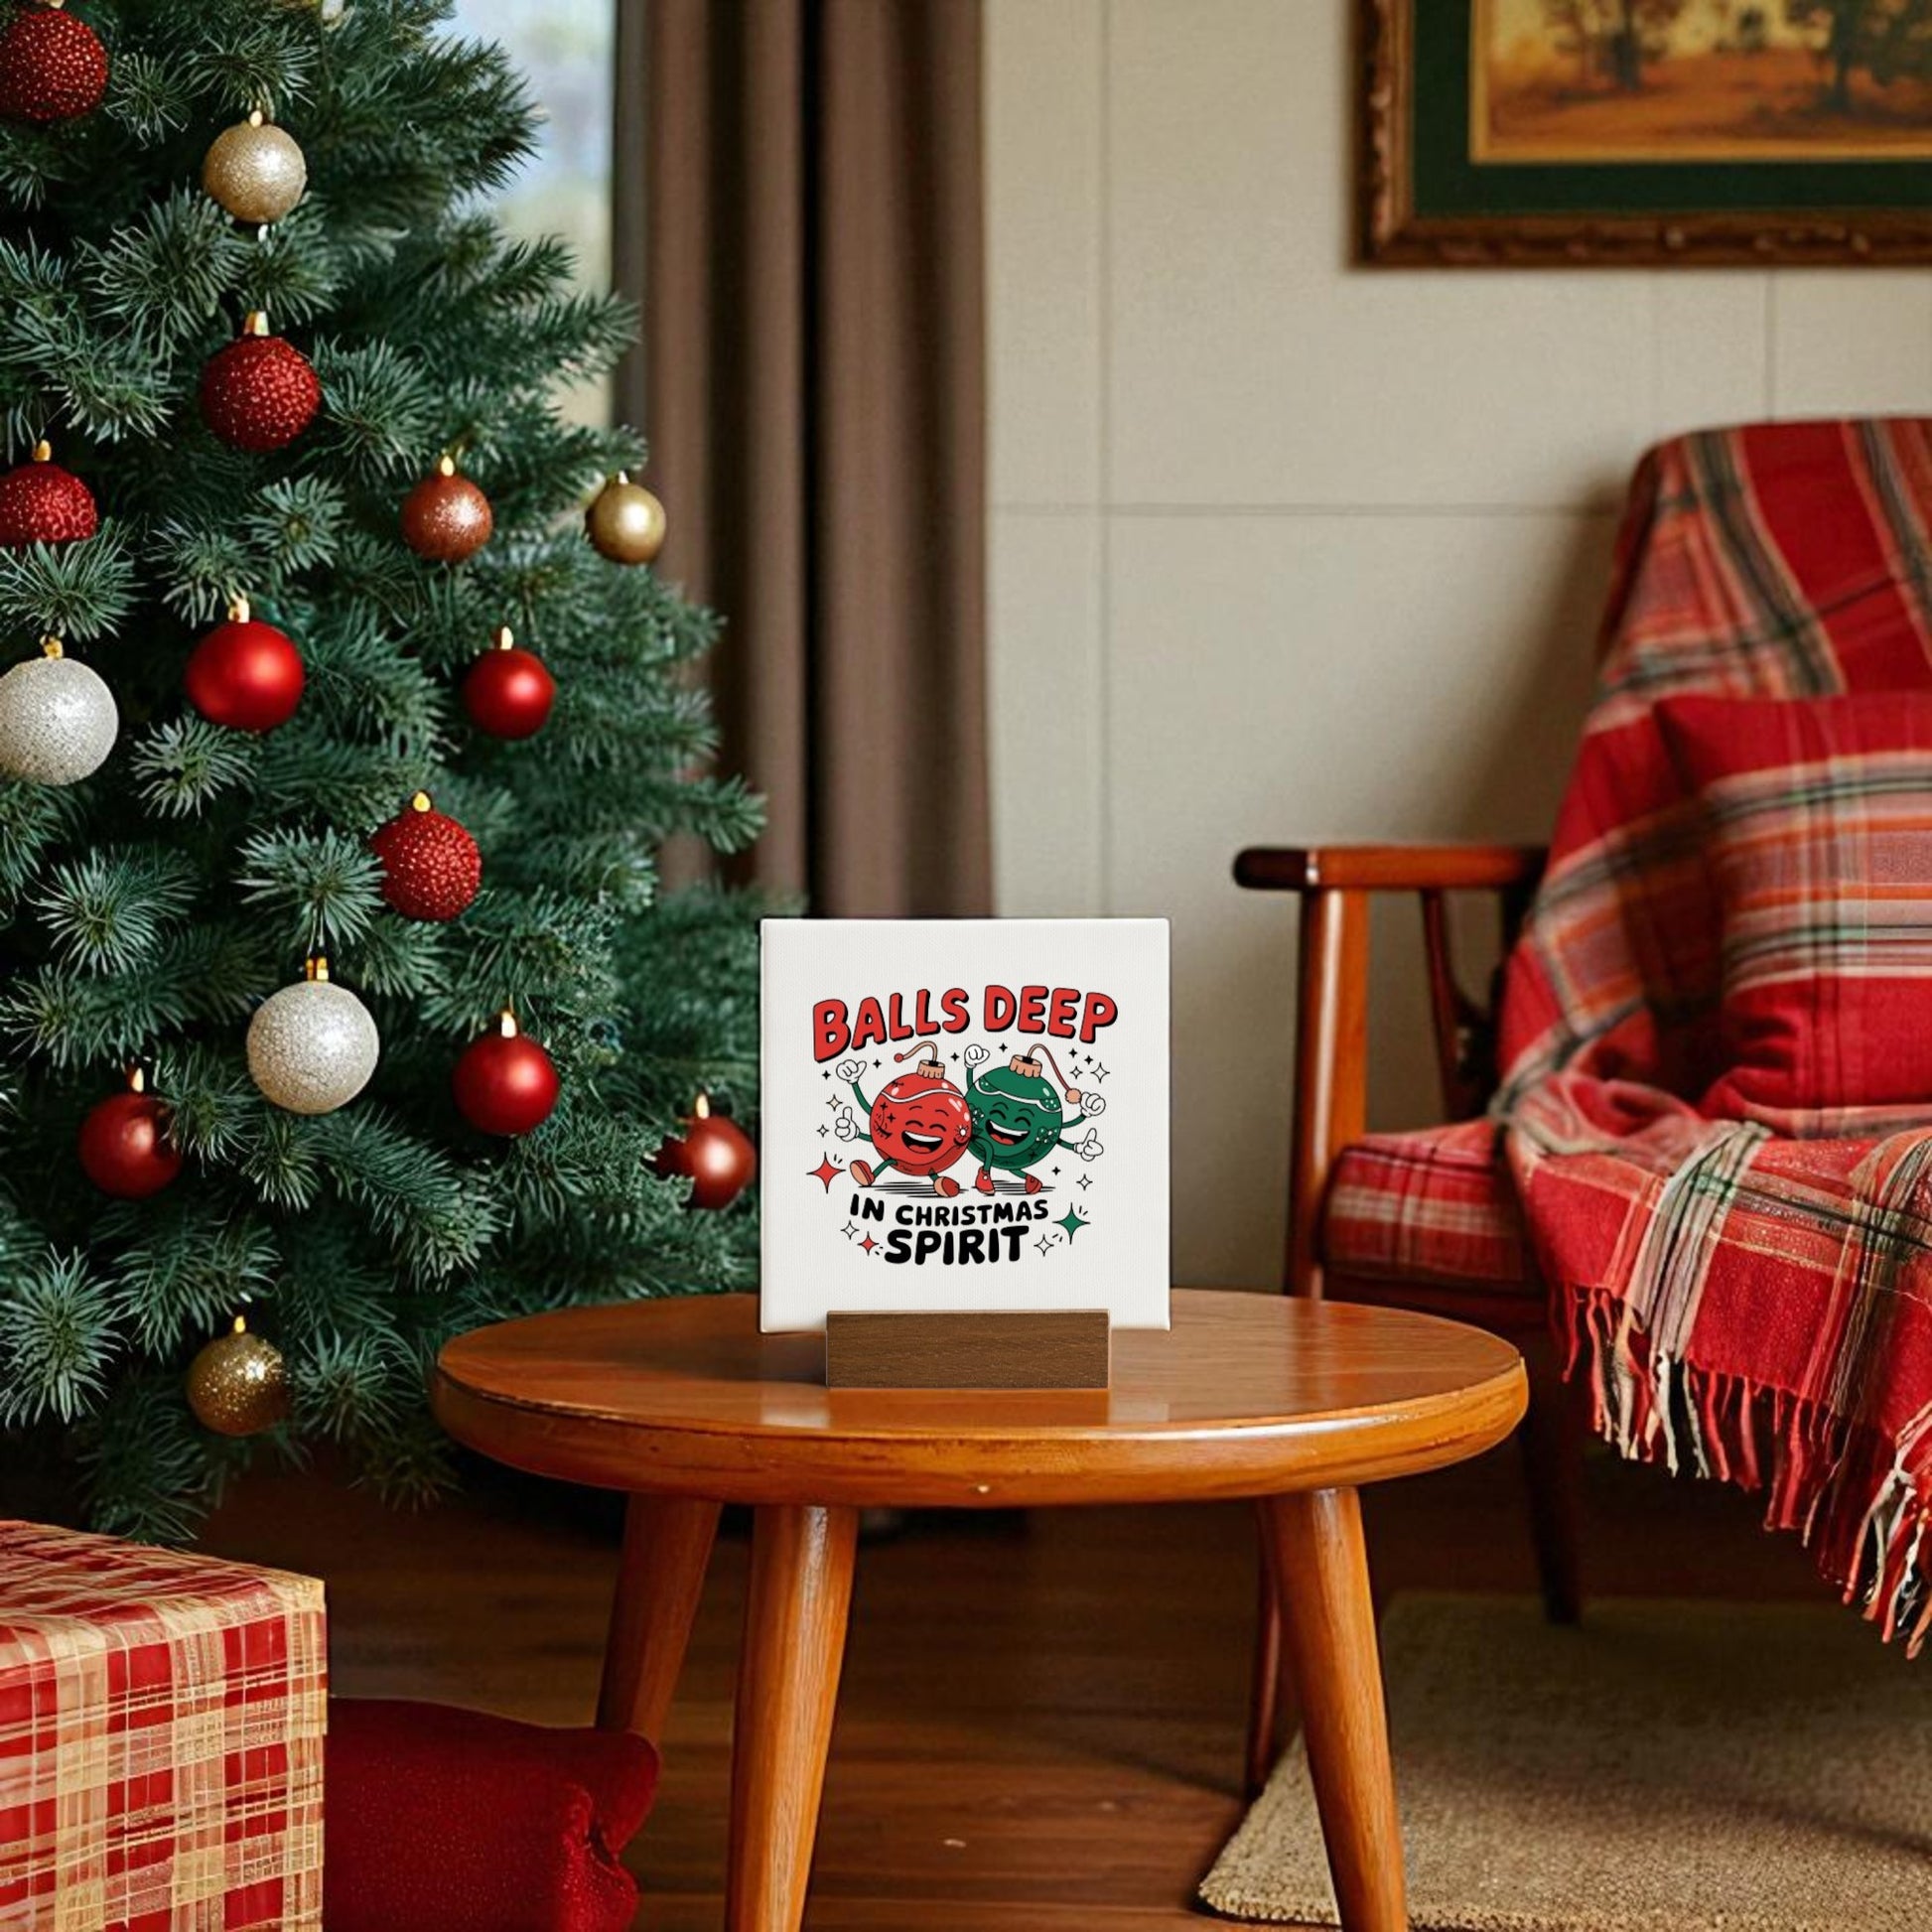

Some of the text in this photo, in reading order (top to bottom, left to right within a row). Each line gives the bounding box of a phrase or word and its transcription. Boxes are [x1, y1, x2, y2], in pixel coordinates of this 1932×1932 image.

[812, 985, 1118, 1063] BALLS DEEP
[850, 1193, 1049, 1226] IN CHRISTMAS
[884, 1225, 1030, 1265] SPIRIT
